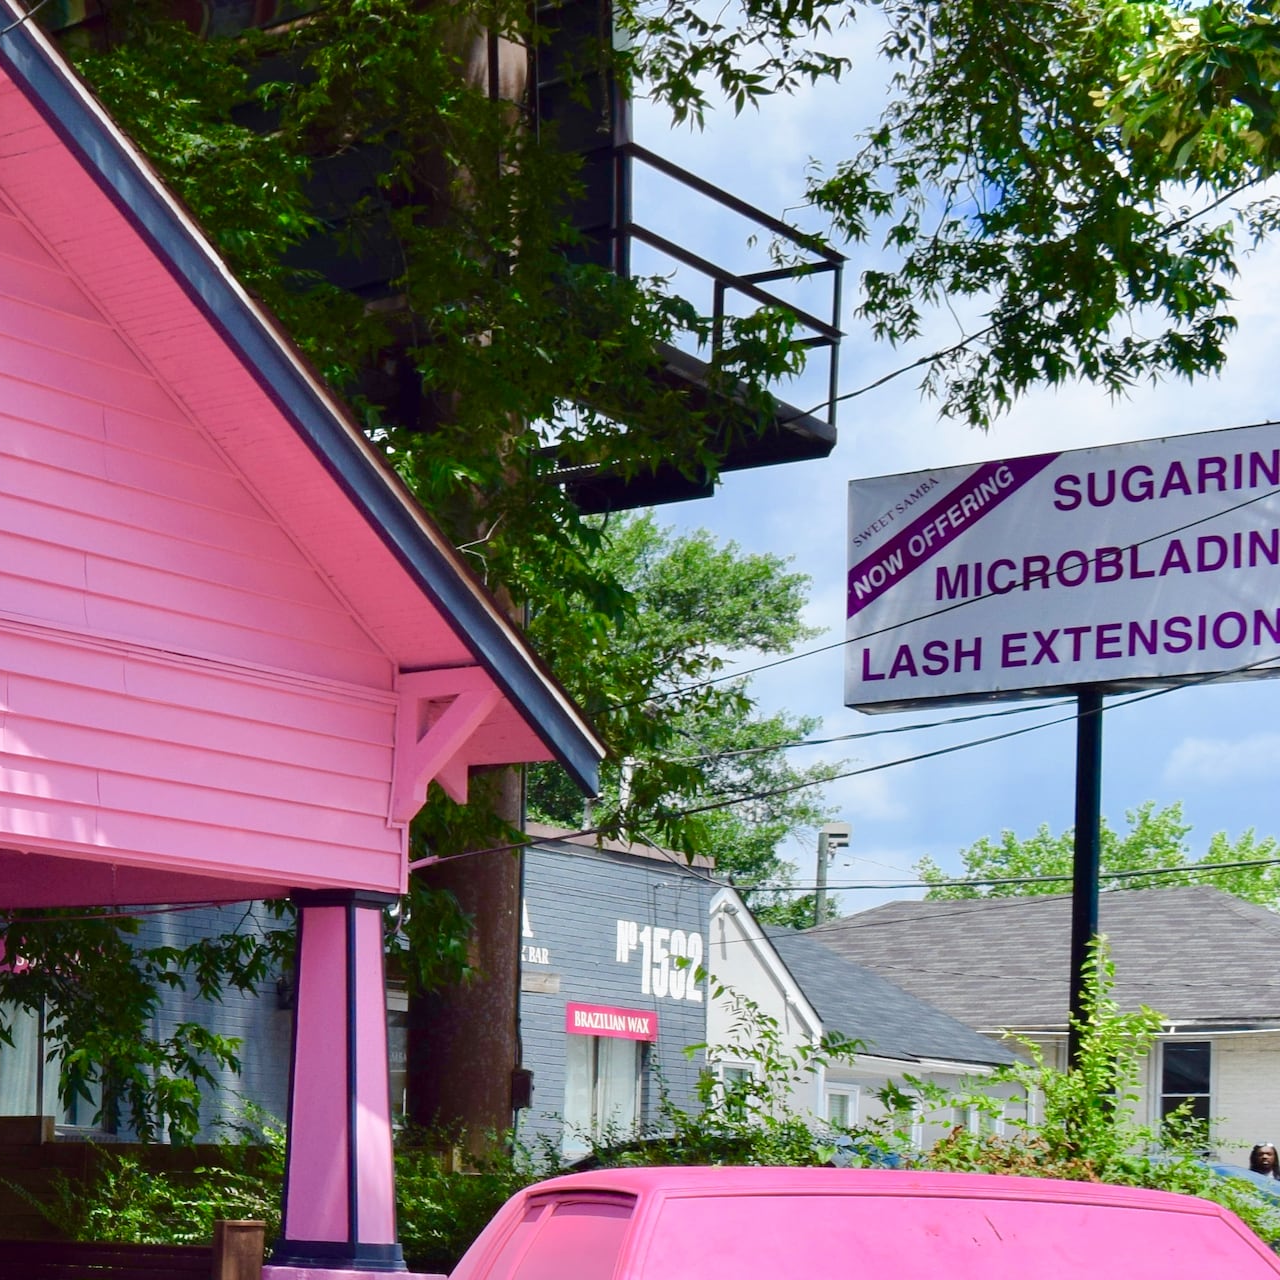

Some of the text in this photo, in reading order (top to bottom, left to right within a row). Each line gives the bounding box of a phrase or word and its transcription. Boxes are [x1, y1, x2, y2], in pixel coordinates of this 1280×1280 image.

[853, 477, 940, 547] SWEET SAMBA
[1054, 449, 1280, 512] SUGARIN
[853, 464, 1015, 600] NOW OFFERING
[935, 528, 1280, 601] MICROBLADIN
[861, 608, 1280, 682] LASH EXTENSION
[527, 946, 550, 965] BAR
[574, 1010, 650, 1034] BRAZILIAN WAX
